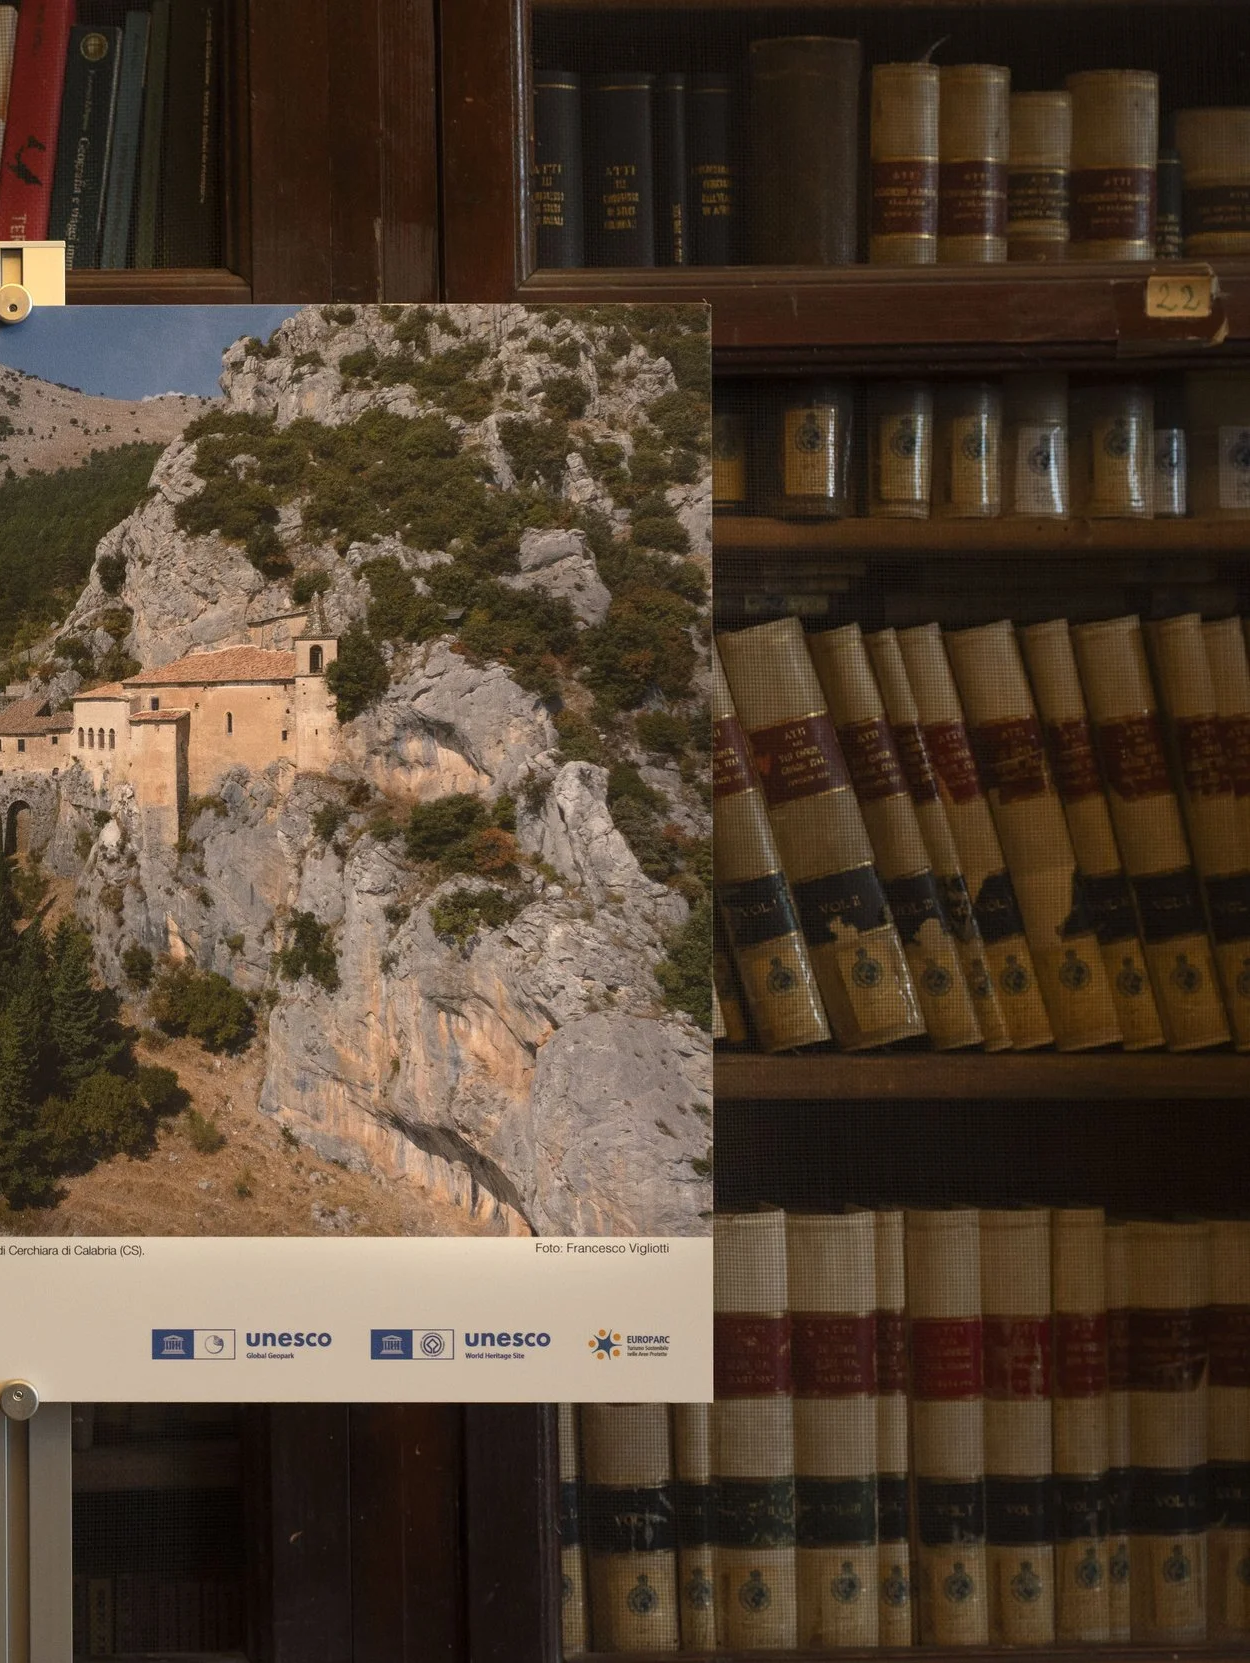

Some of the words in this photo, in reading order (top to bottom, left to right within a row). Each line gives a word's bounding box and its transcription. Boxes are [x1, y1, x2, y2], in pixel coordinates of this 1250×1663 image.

[74, 136, 91, 194] Geografia
[66, 207, 83, 242] viaggi
[1156, 281, 1201, 312] 22
[8, 1244, 59, 1256] Cerchiara
[61, 1245, 72, 1256] di
[73, 1244, 118, 1256] Calabria
[119, 1244, 145, 1258] (CS).
[535, 1242, 563, 1254] Foto:
[566, 1242, 627, 1254] Francesco
[628, 1242, 670, 1257] Vigliotti
[245, 1331, 333, 1348] unesco
[464, 1331, 552, 1348] unesco
[626, 1335, 670, 1344] EUROPARC
[246, 1352, 267, 1360] Global
[268, 1352, 295, 1361] Geopark
[465, 1352, 484, 1360] World
[485, 1352, 512, 1361] Heritage
[513, 1352, 525, 1360] Site
